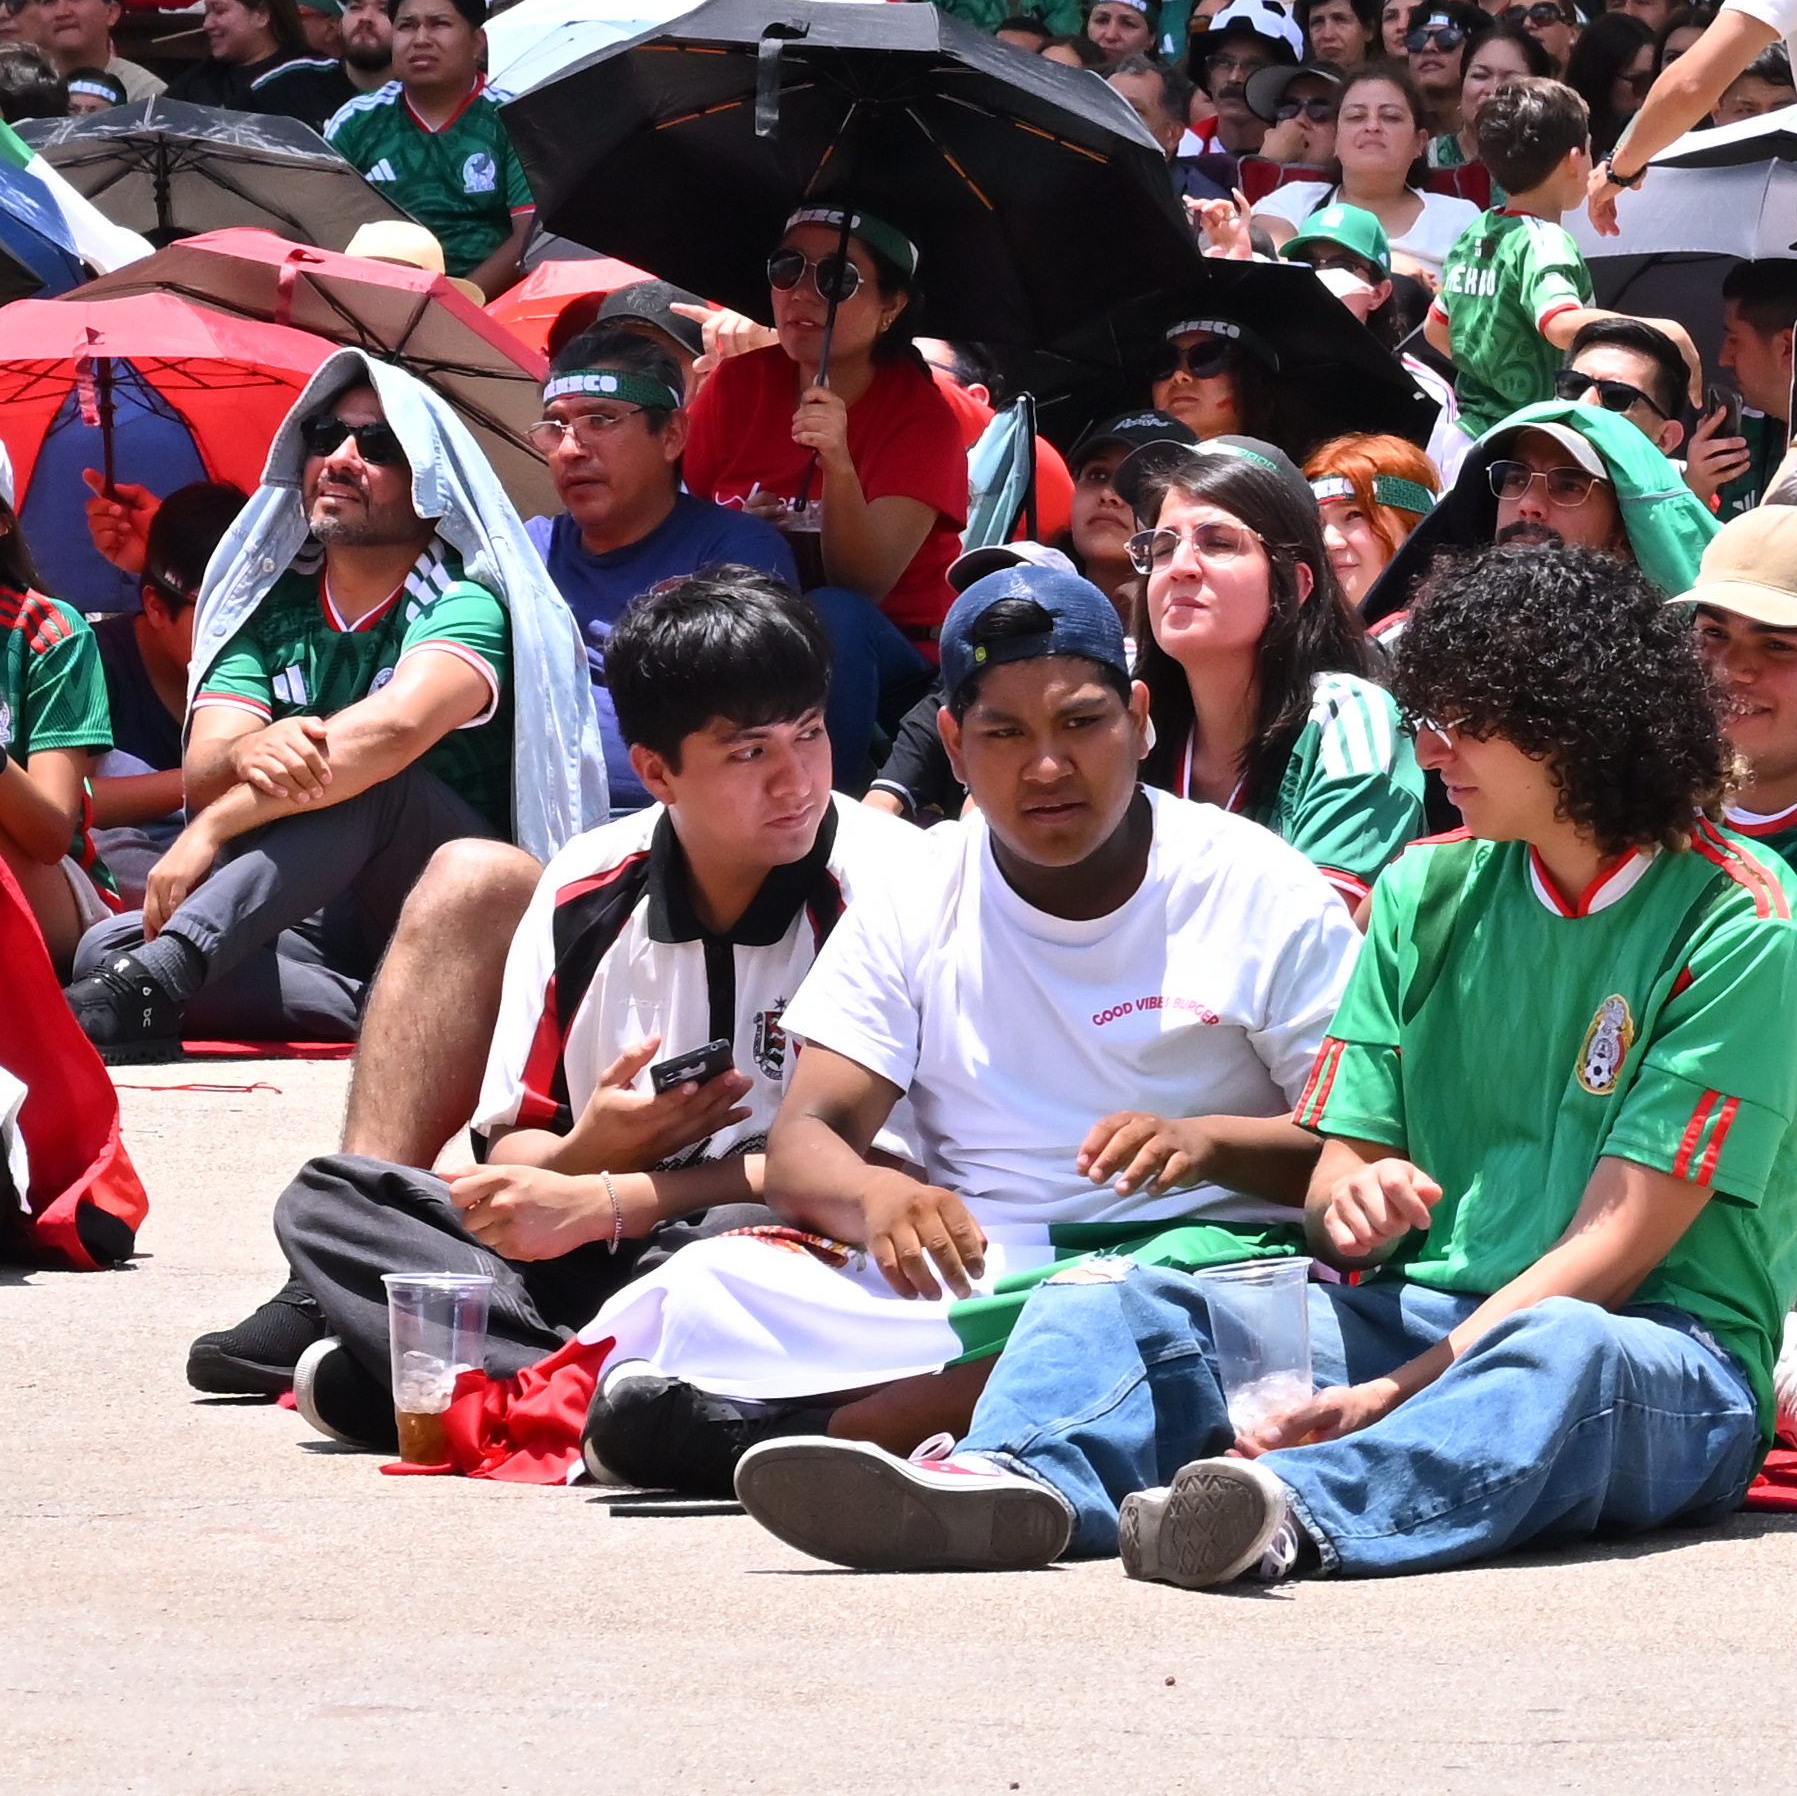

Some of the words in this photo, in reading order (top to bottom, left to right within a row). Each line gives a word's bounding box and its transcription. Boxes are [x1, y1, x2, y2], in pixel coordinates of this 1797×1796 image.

[1091, 1000, 1134, 1027] GOOD
[1136, 996, 1170, 1011] VIBES
[1174, 997, 1221, 1027] BURGER
